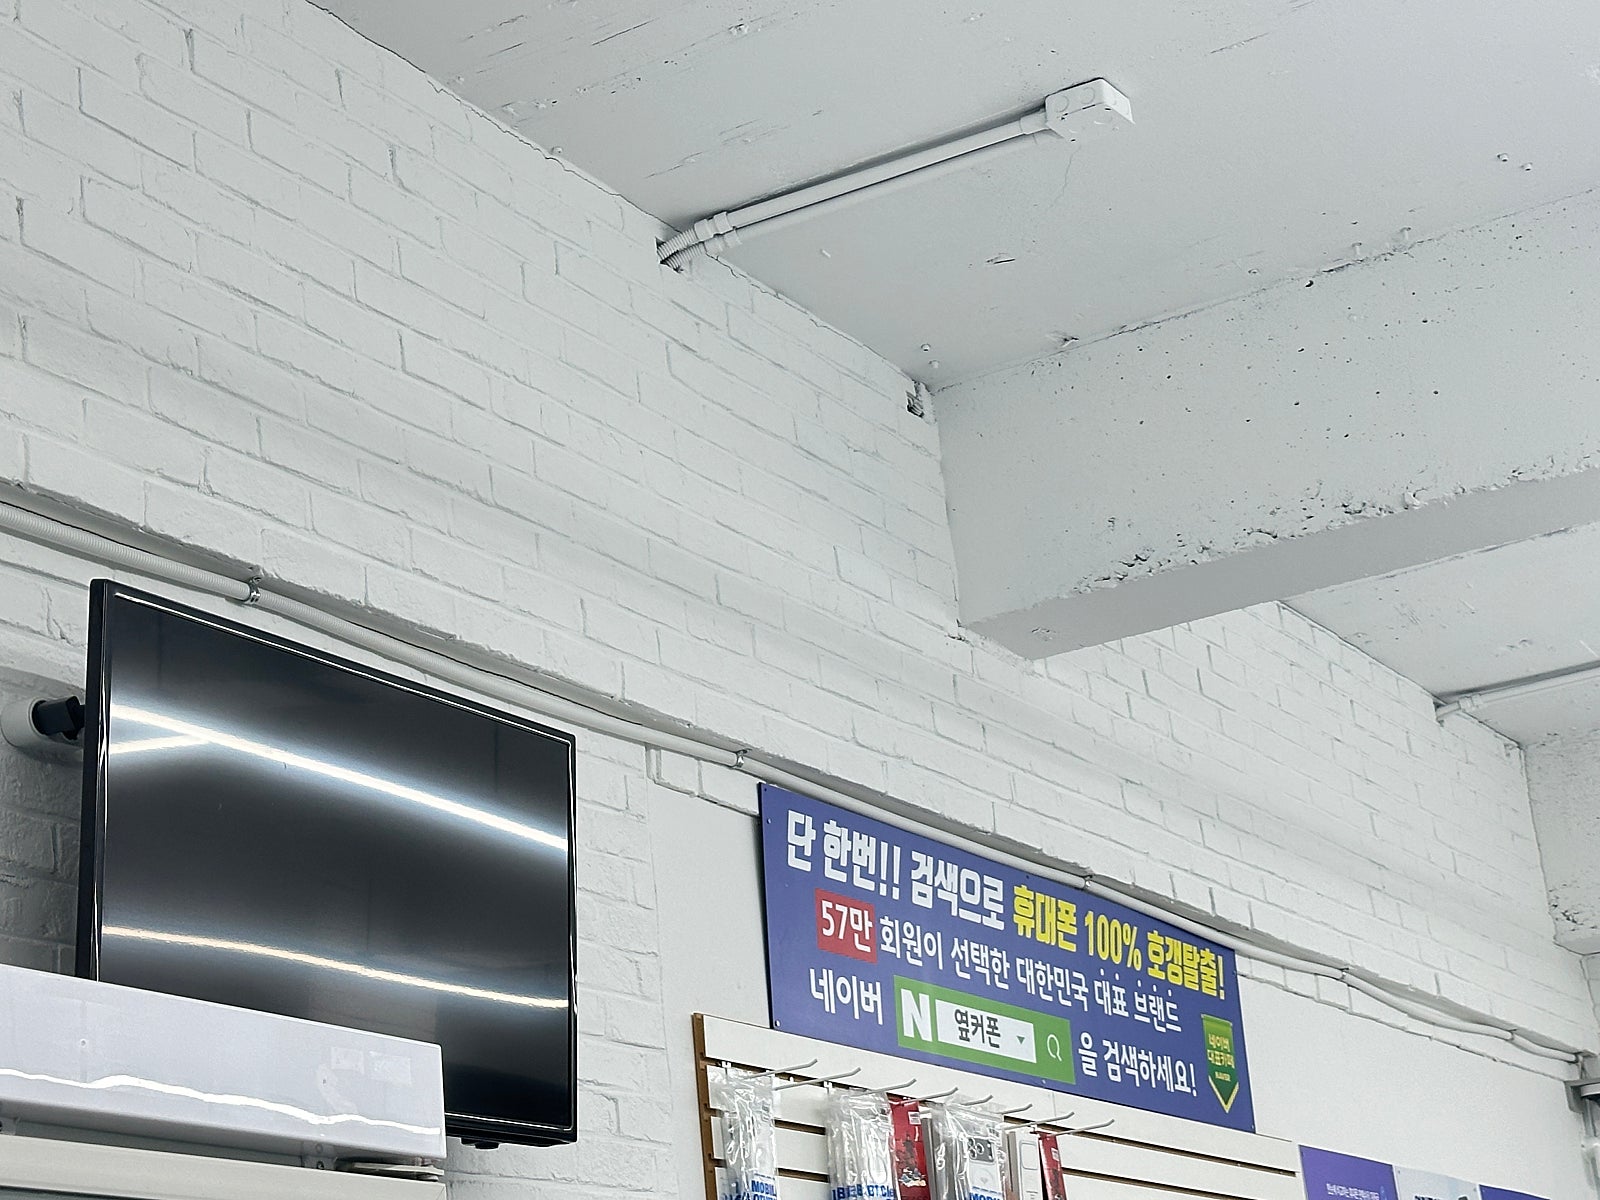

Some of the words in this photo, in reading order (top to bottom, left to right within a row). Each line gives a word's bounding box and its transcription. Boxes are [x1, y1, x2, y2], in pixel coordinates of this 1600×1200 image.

[788, 810, 816, 872] 단
[823, 820, 900, 900] 한번!!
[911, 850, 1005, 930] 검색으로
[1013, 885, 1077, 952] 휴대폰
[1085, 911, 1142, 971] 100%
[1147, 930, 1225, 1000] 호갱탈출!
[821, 900, 873, 952] 57만
[879, 916, 943, 970] 회원이
[951, 937, 1011, 989] 선택한
[1016, 957, 1088, 1012] 대한민국
[1094, 979, 1129, 1017] 대표
[1134, 990, 1182, 1032] 브랜드
[809, 968, 883, 1025] 네이버
[901, 988, 933, 1042] N
[955, 1008, 1001, 1048] 옆커폰
[1078, 1032, 1098, 1077] 을
[1102, 1039, 1197, 1097] 검색하세요!
